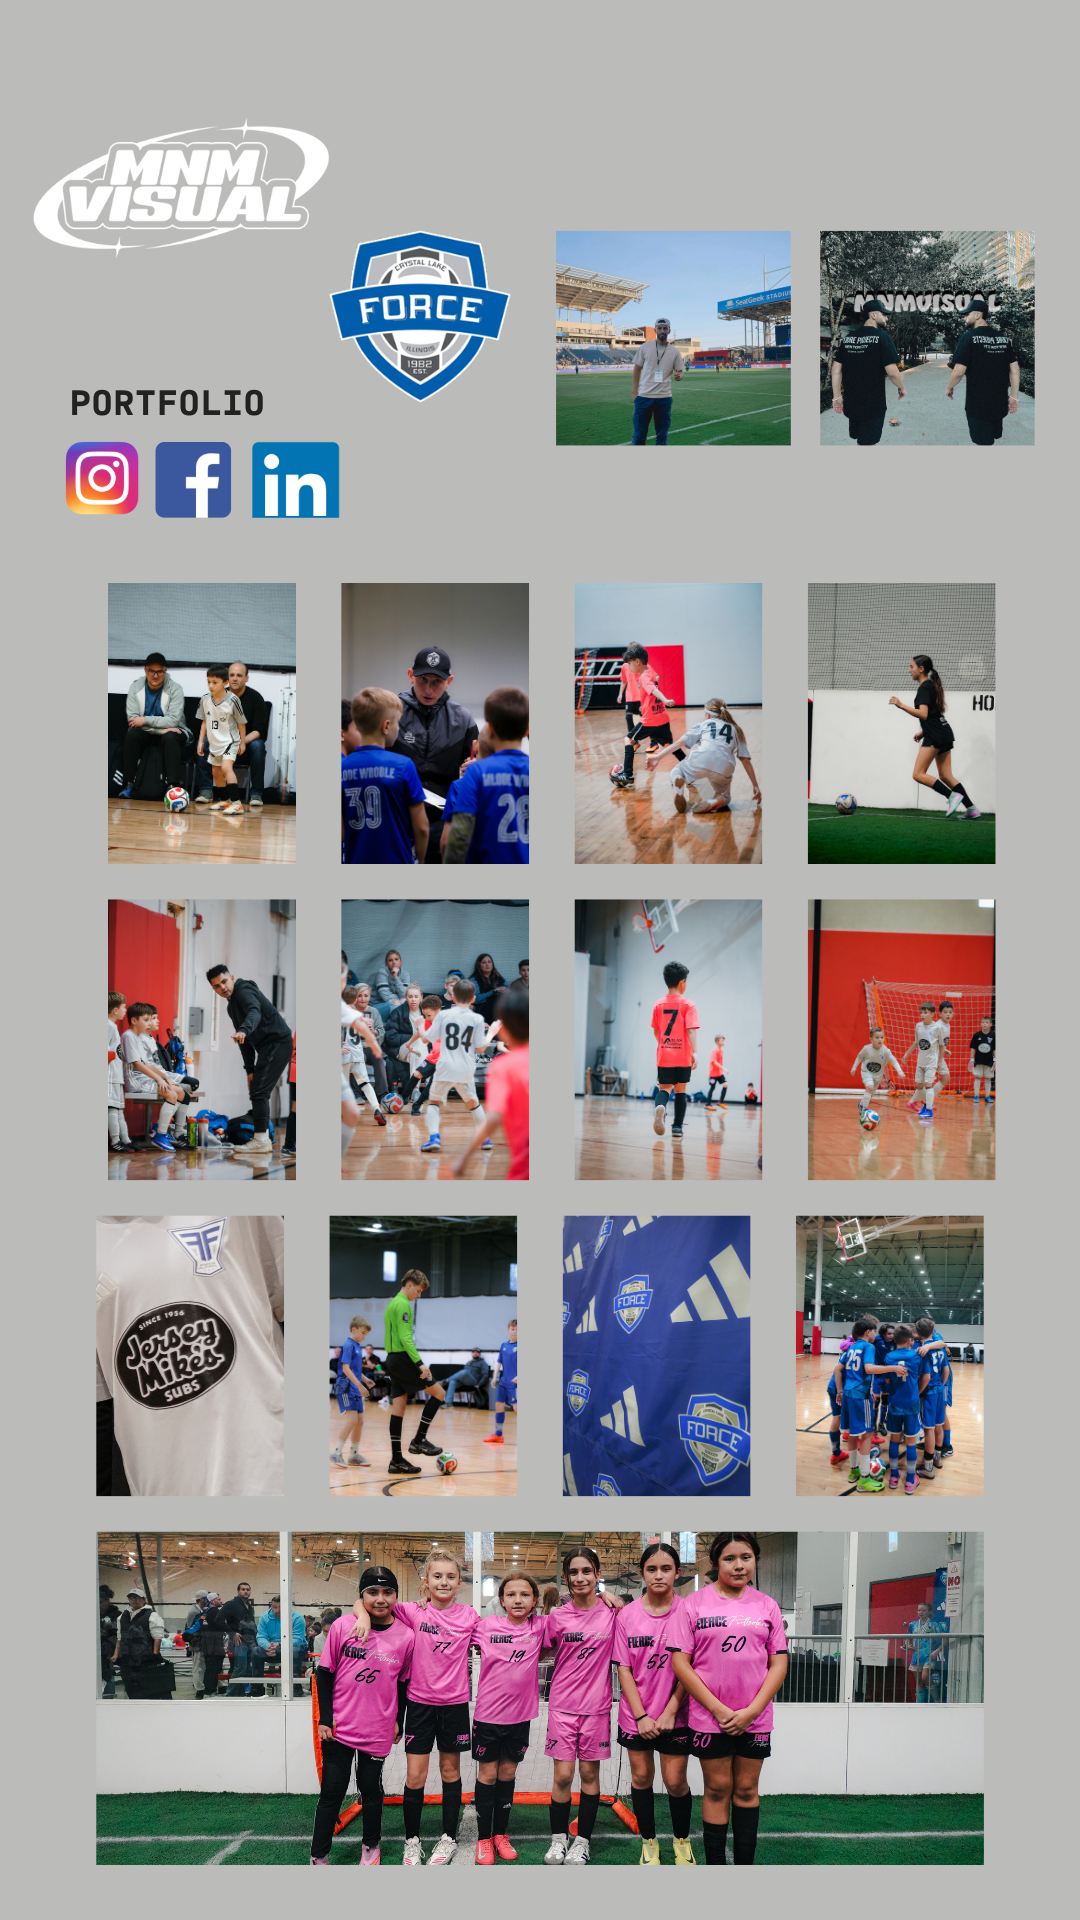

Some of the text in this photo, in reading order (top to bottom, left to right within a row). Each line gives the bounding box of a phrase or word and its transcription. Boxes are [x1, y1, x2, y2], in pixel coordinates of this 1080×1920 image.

[736, 295, 764, 306] SeatGeek
[211, 720, 219, 730] 13
[706, 722, 733, 744] 14
[359, 766, 395, 780] WROBLE
[344, 785, 382, 830] 39
[497, 793, 529, 844] 28
[663, 1009, 678, 1036] 7
[445, 1022, 474, 1053] 84
[617, 1293, 647, 1308] FORCE
[139, 1309, 185, 1331] SINCE 1956
[127, 1318, 220, 1369] Jersey
[846, 1349, 862, 1371] 25
[137, 1345, 225, 1398] Mike's
[164, 1380, 200, 1402] SUBS
[687, 1420, 742, 1453] FORCE
[948, 1576, 960, 1586] NO
[696, 1615, 727, 1630] FIERCE
[490, 1633, 513, 1643] FIERCE
[627, 1636, 654, 1648] FIERCE
[721, 1635, 747, 1652] 50
[432, 1641, 452, 1653] 77
[577, 1647, 597, 1660] 87
[508, 1649, 526, 1662] 19
[647, 1653, 669, 1669] 52
[354, 1668, 381, 1683] 65
[693, 1732, 712, 1748] 50
[475, 1744, 487, 1756] 19
